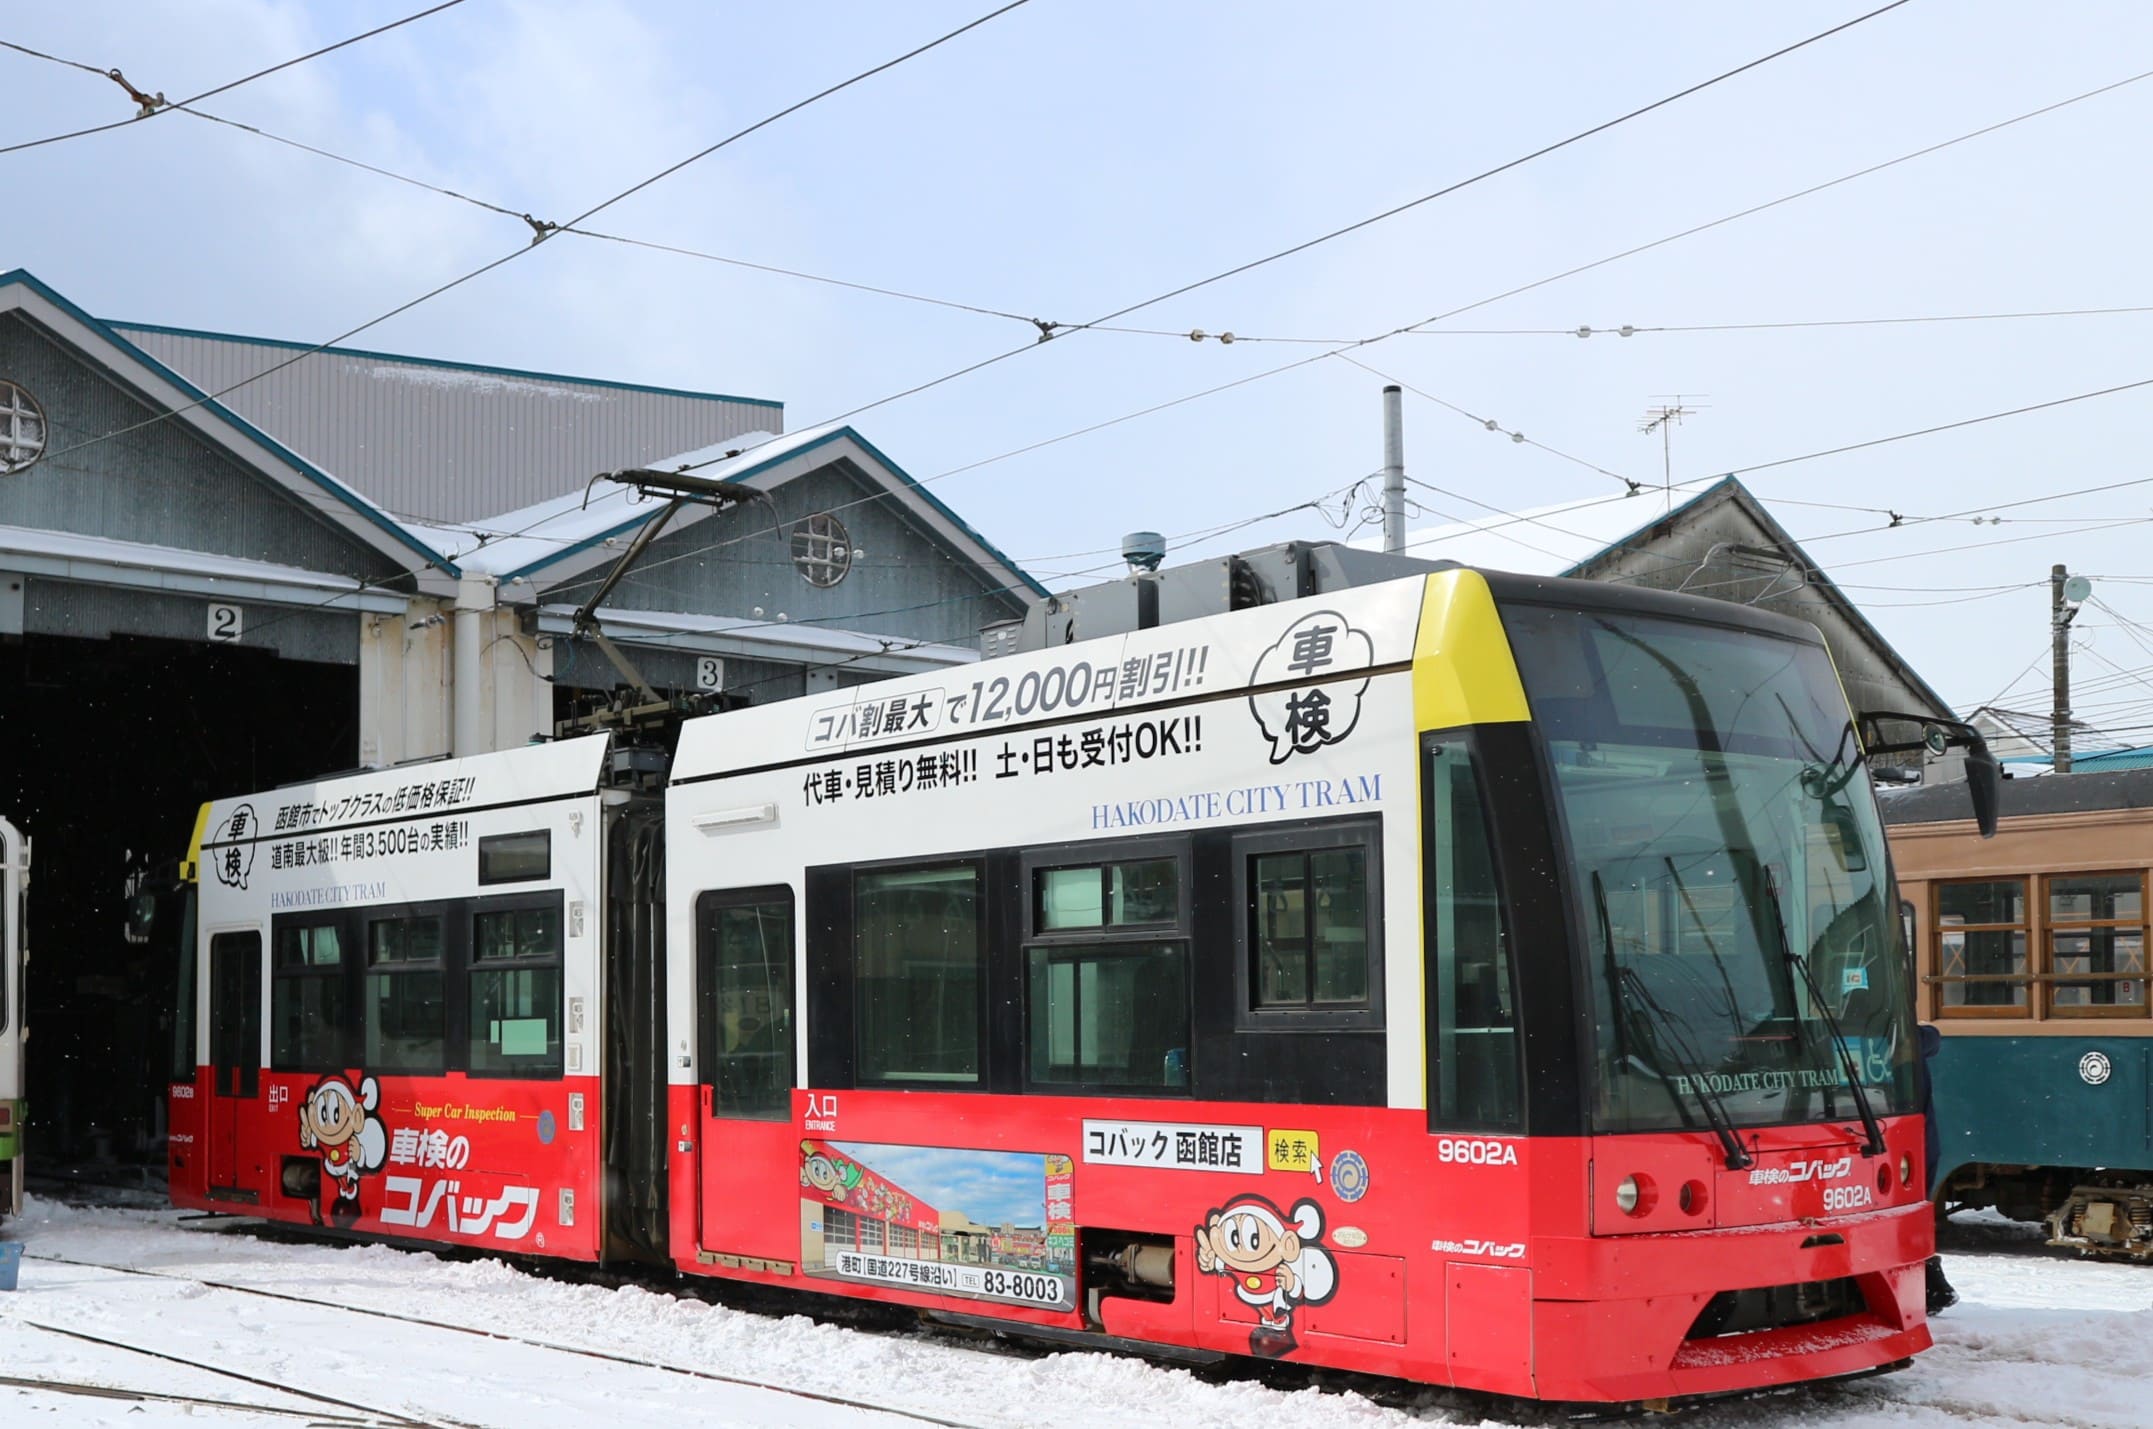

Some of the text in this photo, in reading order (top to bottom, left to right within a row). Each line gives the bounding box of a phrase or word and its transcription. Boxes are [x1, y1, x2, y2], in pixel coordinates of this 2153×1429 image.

[215, 607, 236, 638] 2
[702, 660, 719, 687] 3
[814, 694, 934, 744] コバ割最大
[1092, 773, 1384, 830] HAKODATE CITY TRAM
[271, 881, 386, 909] HAKODATE CITY TRAM
[268, 1083, 288, 1103] 出口
[1763, 1070, 1796, 1090] CITY
[1799, 1069, 1840, 1088] TRAM
[414, 1102, 516, 1124] Super Car Inspection
[804, 1093, 838, 1118] 入口
[805, 1119, 836, 1132] ENTRANCE
[390, 1126, 471, 1170] 車検の
[1088, 1127, 1243, 1168] コバック 函館店
[1274, 1138, 1308, 1165] 検索
[1438, 1139, 1518, 1165] 9602A
[380, 1175, 541, 1240] コバック
[1822, 1185, 1872, 1211] 9602A
[964, 1270, 1059, 1302] TEL 83-8003
